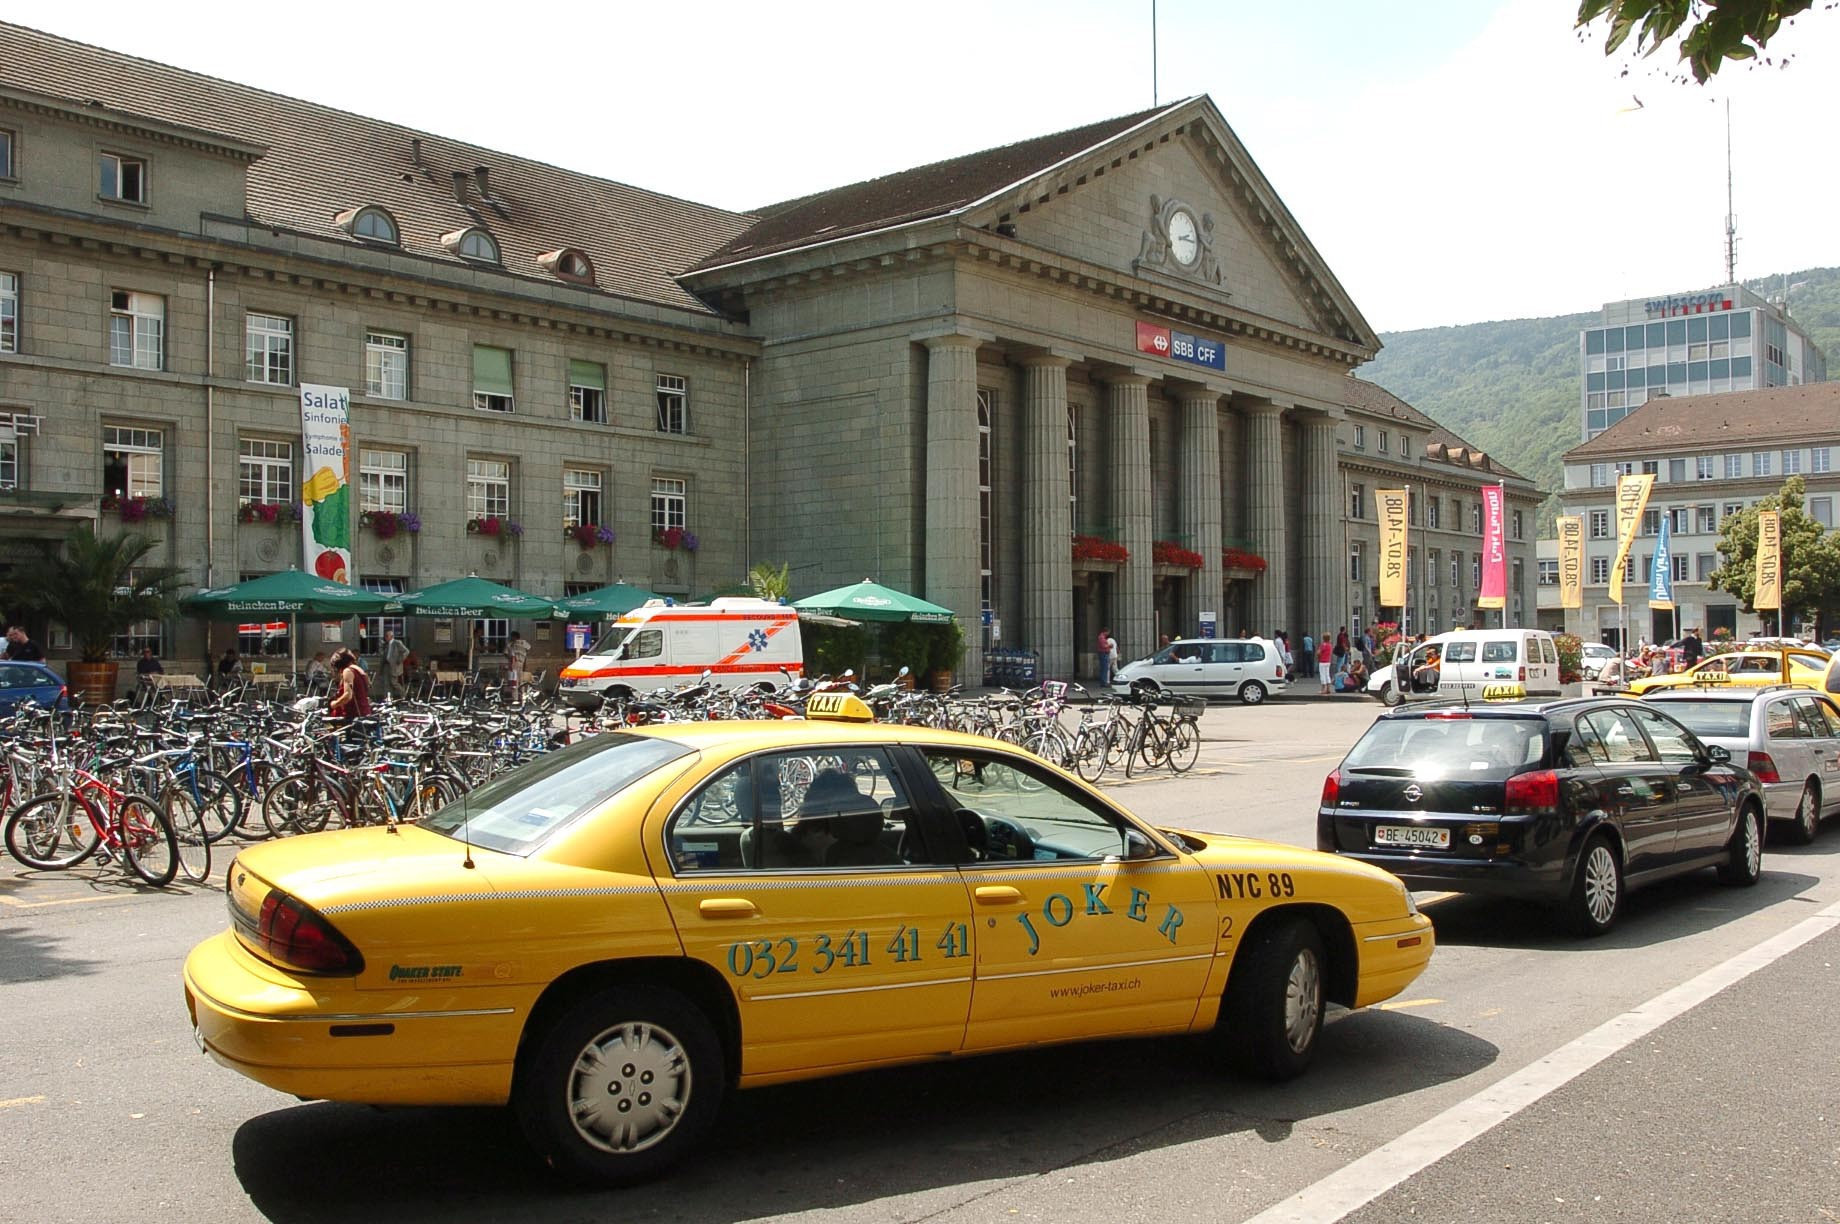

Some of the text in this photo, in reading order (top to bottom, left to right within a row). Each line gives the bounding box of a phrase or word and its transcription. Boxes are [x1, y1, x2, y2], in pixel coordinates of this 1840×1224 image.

[1645, 292, 1724, 313] swisscom
[1174, 340, 1216, 363] SBB CFF
[304, 391, 346, 411] Salat
[228, 600, 304, 611] Heineken Beer
[416, 606, 484, 617] Heineken Beer
[1696, 672, 1724, 681] TAXI
[1487, 685, 1518, 697] TAXI
[809, 695, 842, 713] TAXI
[1216, 872, 1295, 899] NYC 89
[1016, 882, 1184, 956] JOKER
[1221, 916, 1233, 939] 2
[727, 920, 970, 979] 032 341 41 41
[1049, 977, 1141, 999] www.joker-taxi.ch
